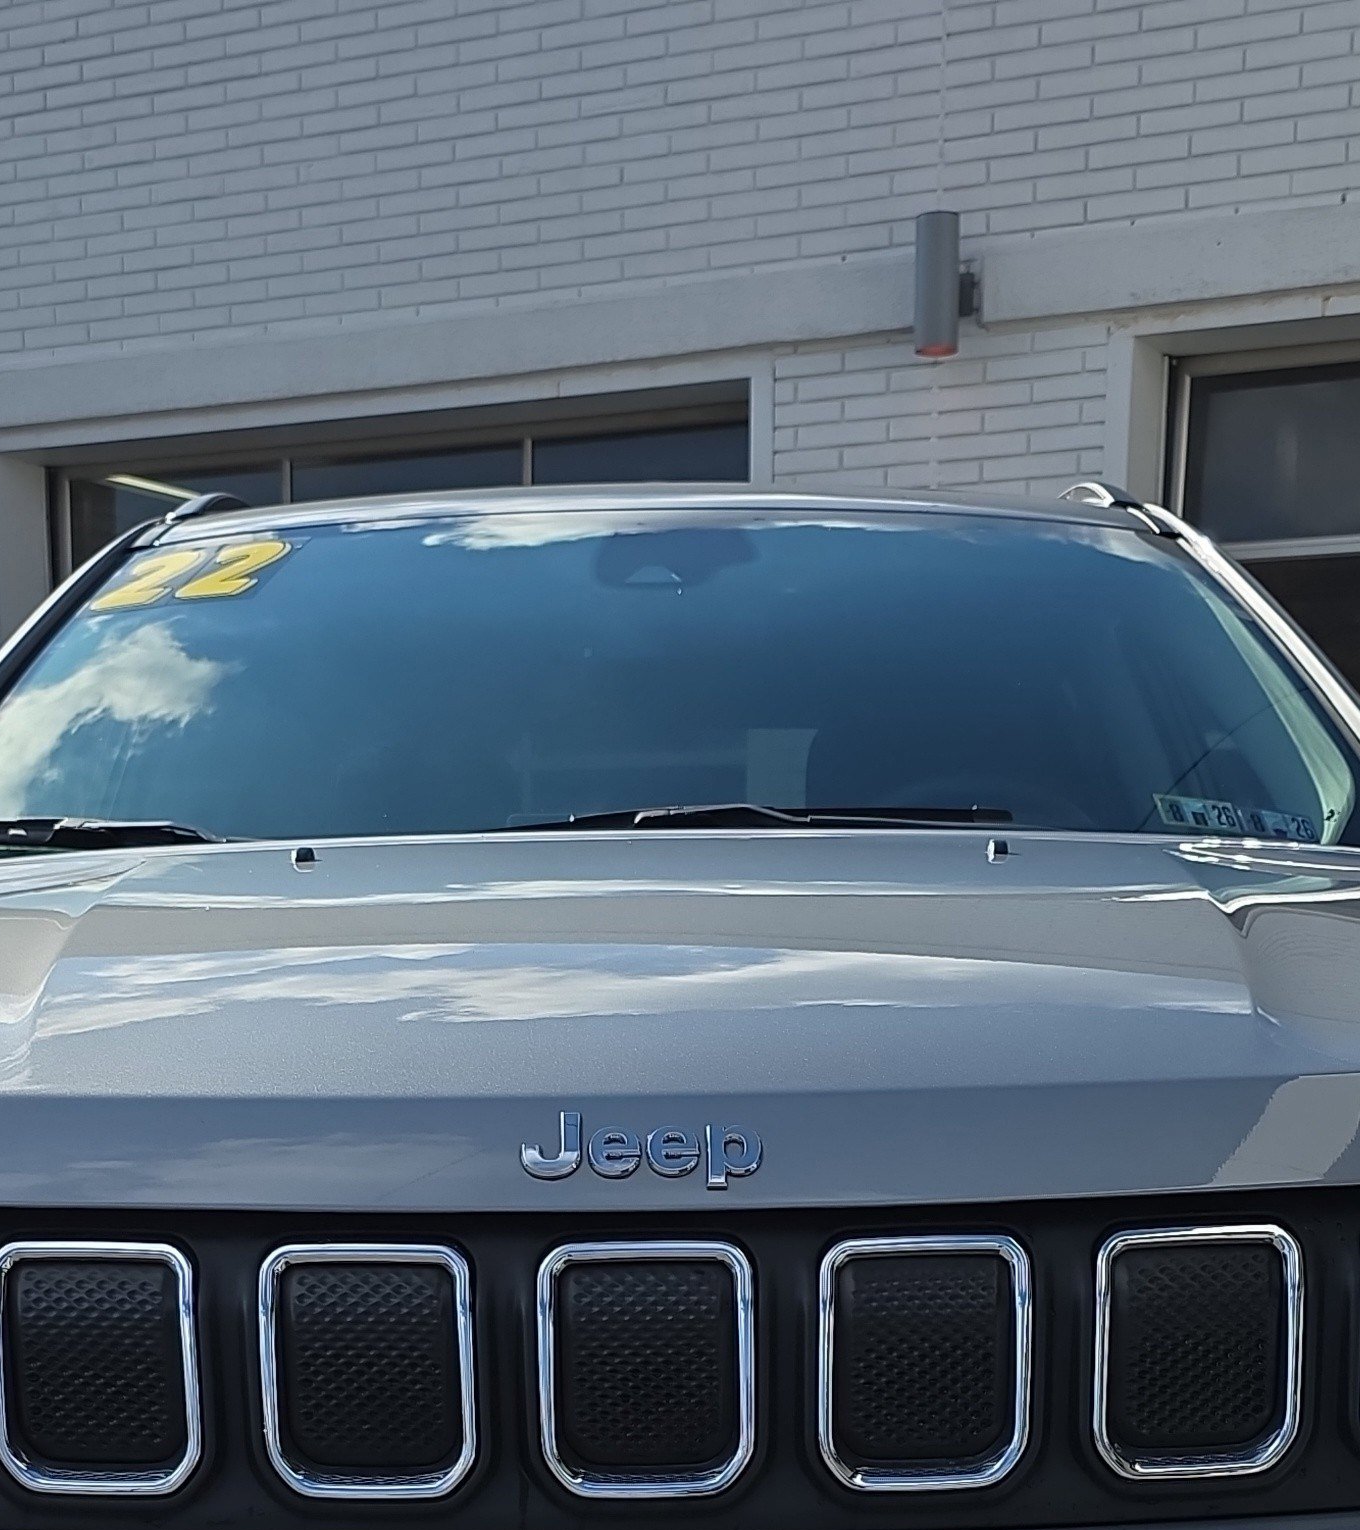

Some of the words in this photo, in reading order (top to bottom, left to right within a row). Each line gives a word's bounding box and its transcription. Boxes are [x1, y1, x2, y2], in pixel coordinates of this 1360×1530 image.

[90, 540, 293, 613] 22
[1211, 804, 1237, 828] 26
[1291, 817, 1315, 840] 26
[520, 1110, 763, 1190] Jeep
